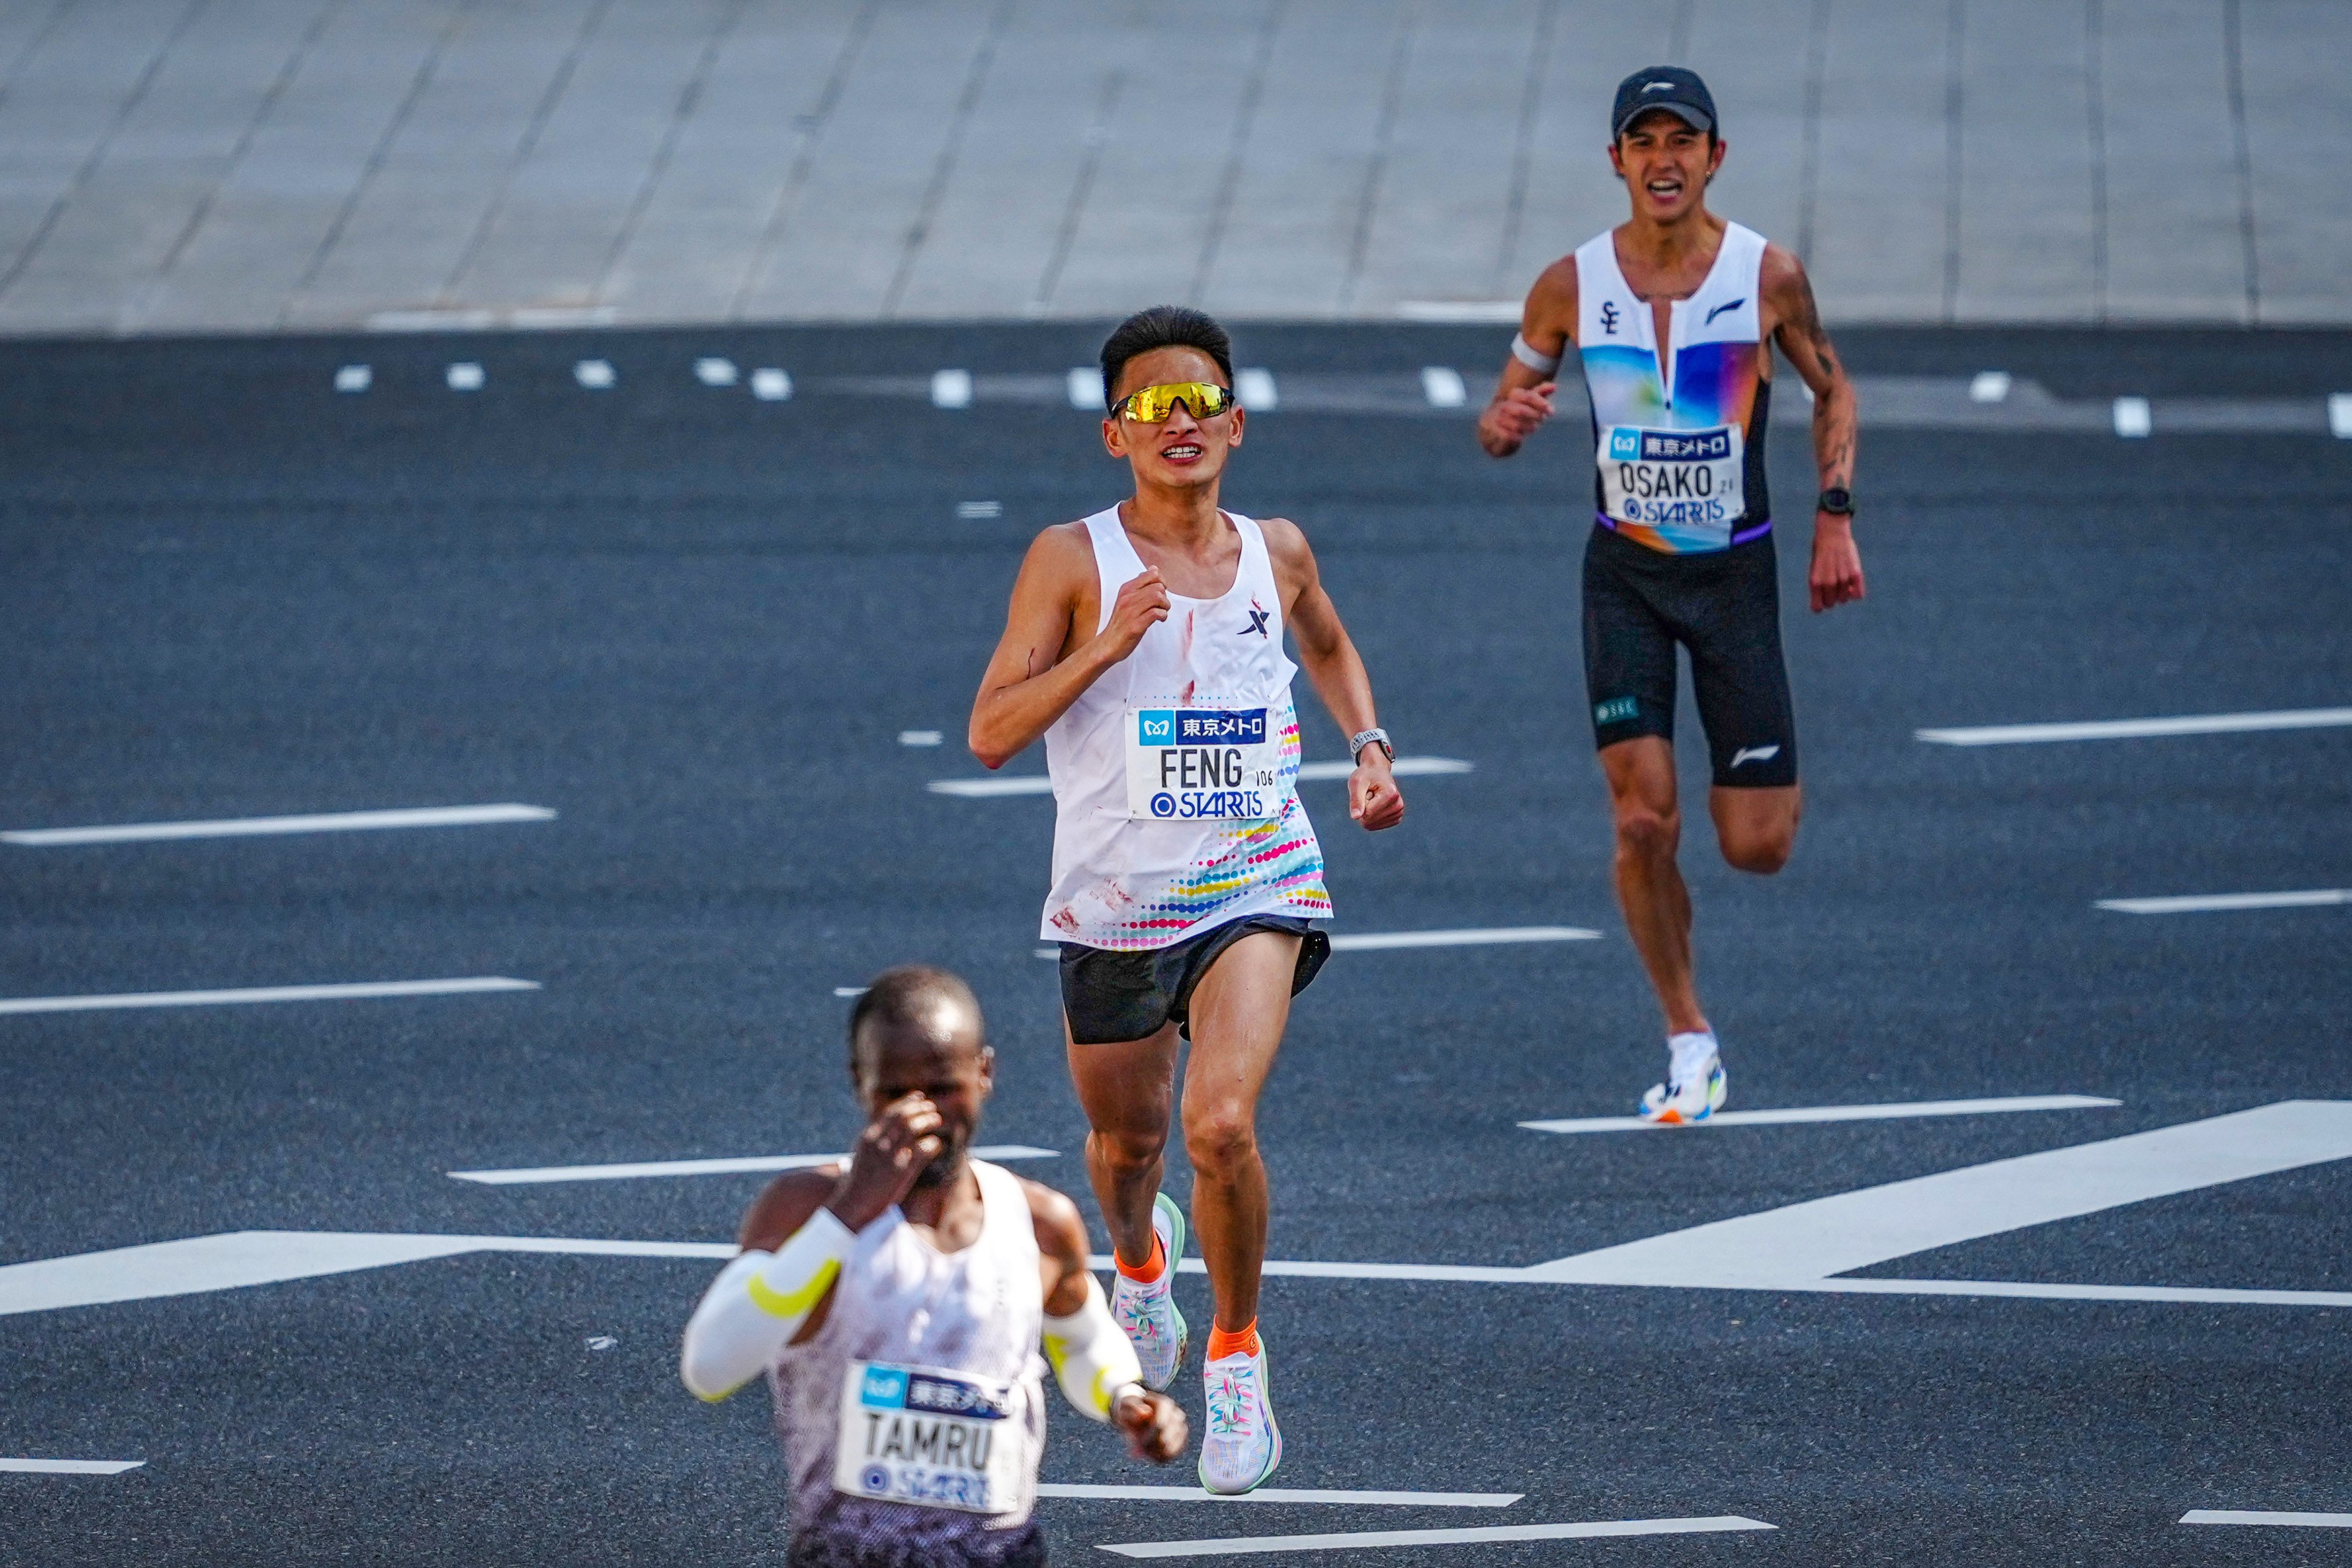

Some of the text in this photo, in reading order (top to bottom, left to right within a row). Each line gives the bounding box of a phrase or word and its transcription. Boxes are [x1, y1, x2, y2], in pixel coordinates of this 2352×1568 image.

[1646, 437, 1726, 457] 東京メトロ
[1619, 462, 1712, 498] OSAKO
[1182, 718, 1263, 737] 東京メトロ
[1161, 748, 1273, 788] FENG 106
[866, 1412, 992, 1471] TAMRU
